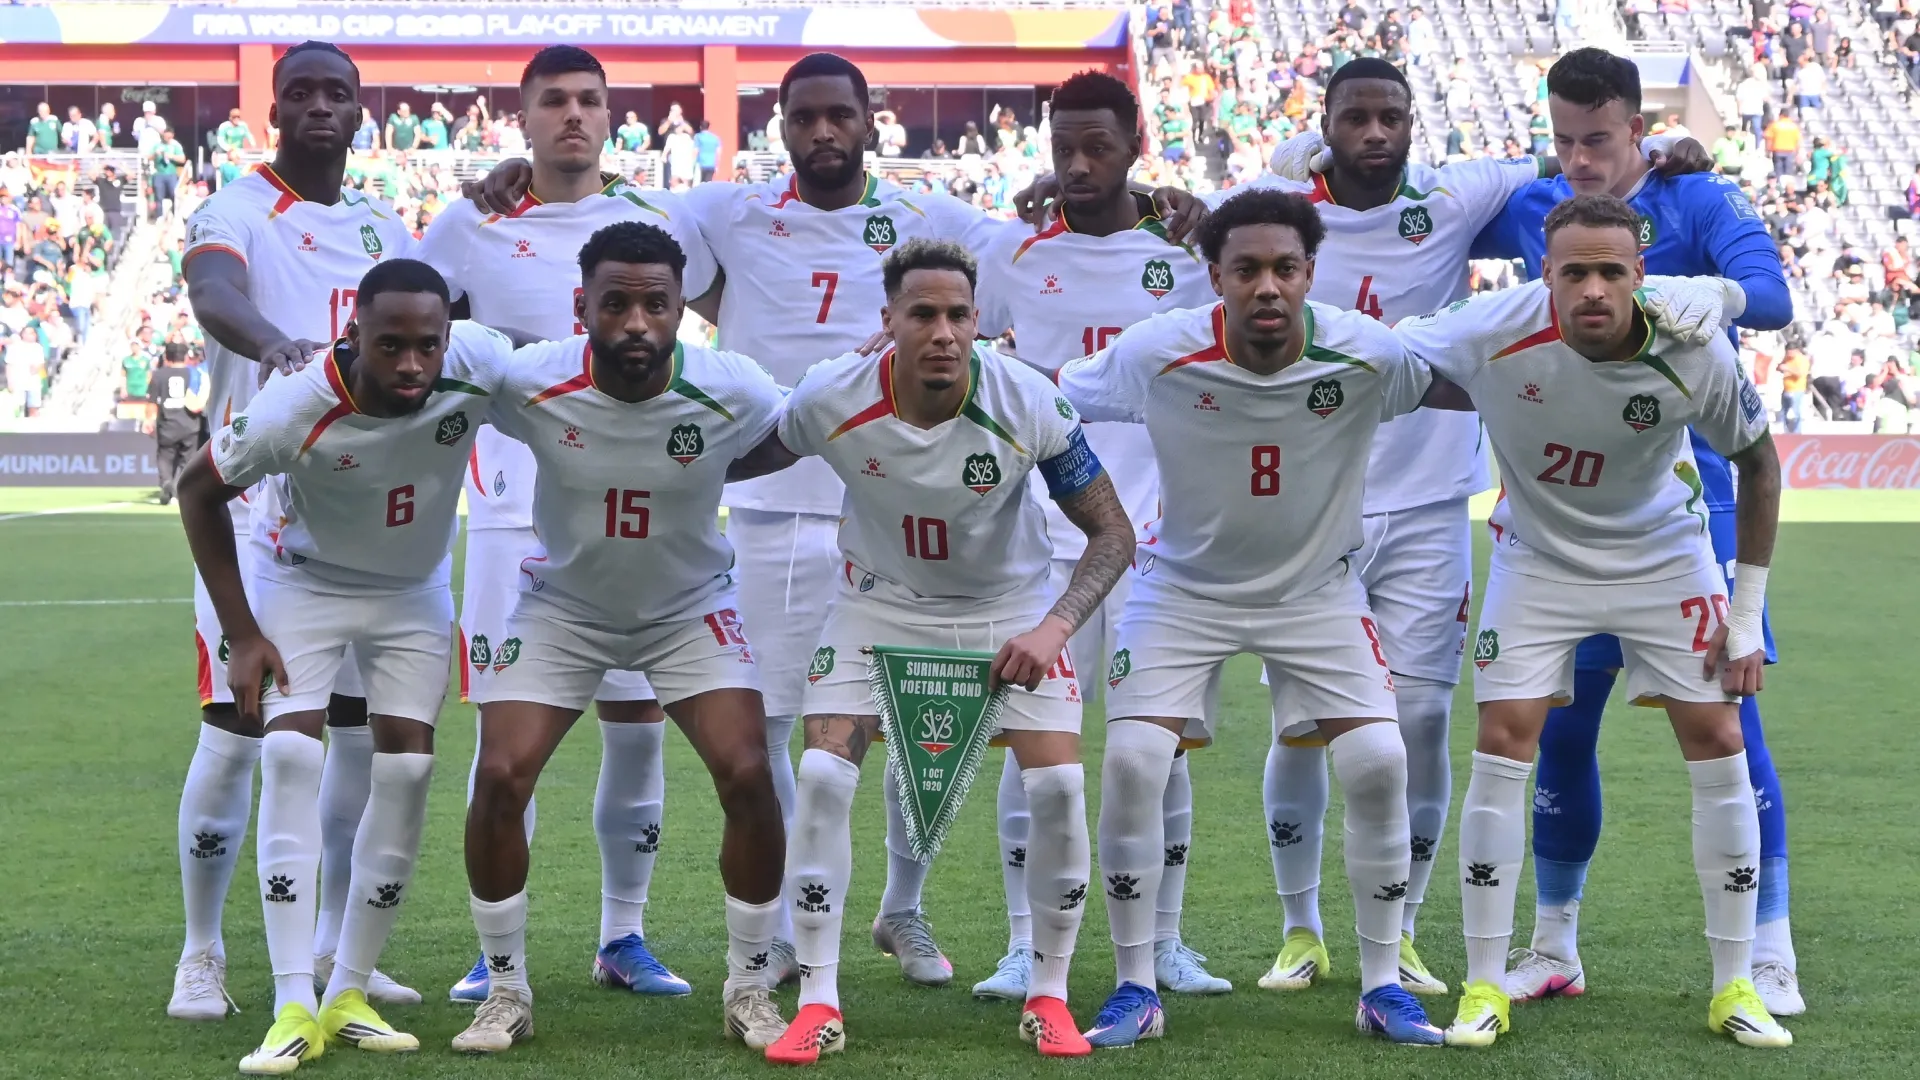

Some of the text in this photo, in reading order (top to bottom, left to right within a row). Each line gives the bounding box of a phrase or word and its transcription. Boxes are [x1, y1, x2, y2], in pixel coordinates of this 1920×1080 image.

[192, 14, 247, 36] FIFA
[249, 14, 341, 36] WORLD
[342, 14, 394, 36] CUP
[487, 14, 602, 36] PLAY-OFF
[607, 14, 780, 37] TOURNAMENT
[768, 230, 791, 238] KELME
[812, 271, 839, 324] 7
[1355, 275, 1384, 320] 4
[1517, 393, 1544, 404] KELME
[1193, 403, 1221, 412] KELME
[558, 439, 585, 449] KELME
[1054, 441, 1087, 465] FOOTBALL
[105, 454, 137, 474] DE
[141, 454, 159, 474] L
[333, 463, 360, 472] KELME
[1057, 450, 1089, 475] UNITES
[1537, 443, 1605, 488] 20
[1780, 438, 1920, 489] Coca-Col
[860, 469, 887, 479] KELME
[1251, 445, 1280, 497] 8
[385, 484, 414, 528] 6
[604, 488, 651, 539] 15
[901, 514, 949, 561] 10
[906, 661, 980, 680] SURINAAMSE
[900, 679, 982, 697] VOETBAL BOND
[922, 767, 944, 779] 1 OCT
[922, 781, 942, 792] 1920
[1272, 834, 1303, 849] KELME
[190, 847, 227, 858] KELME
[1466, 877, 1500, 887] KELME
[1724, 880, 1758, 893] KELME
[265, 893, 297, 903] KELME
[1107, 889, 1141, 901] KELME
[796, 899, 831, 913] KELME
